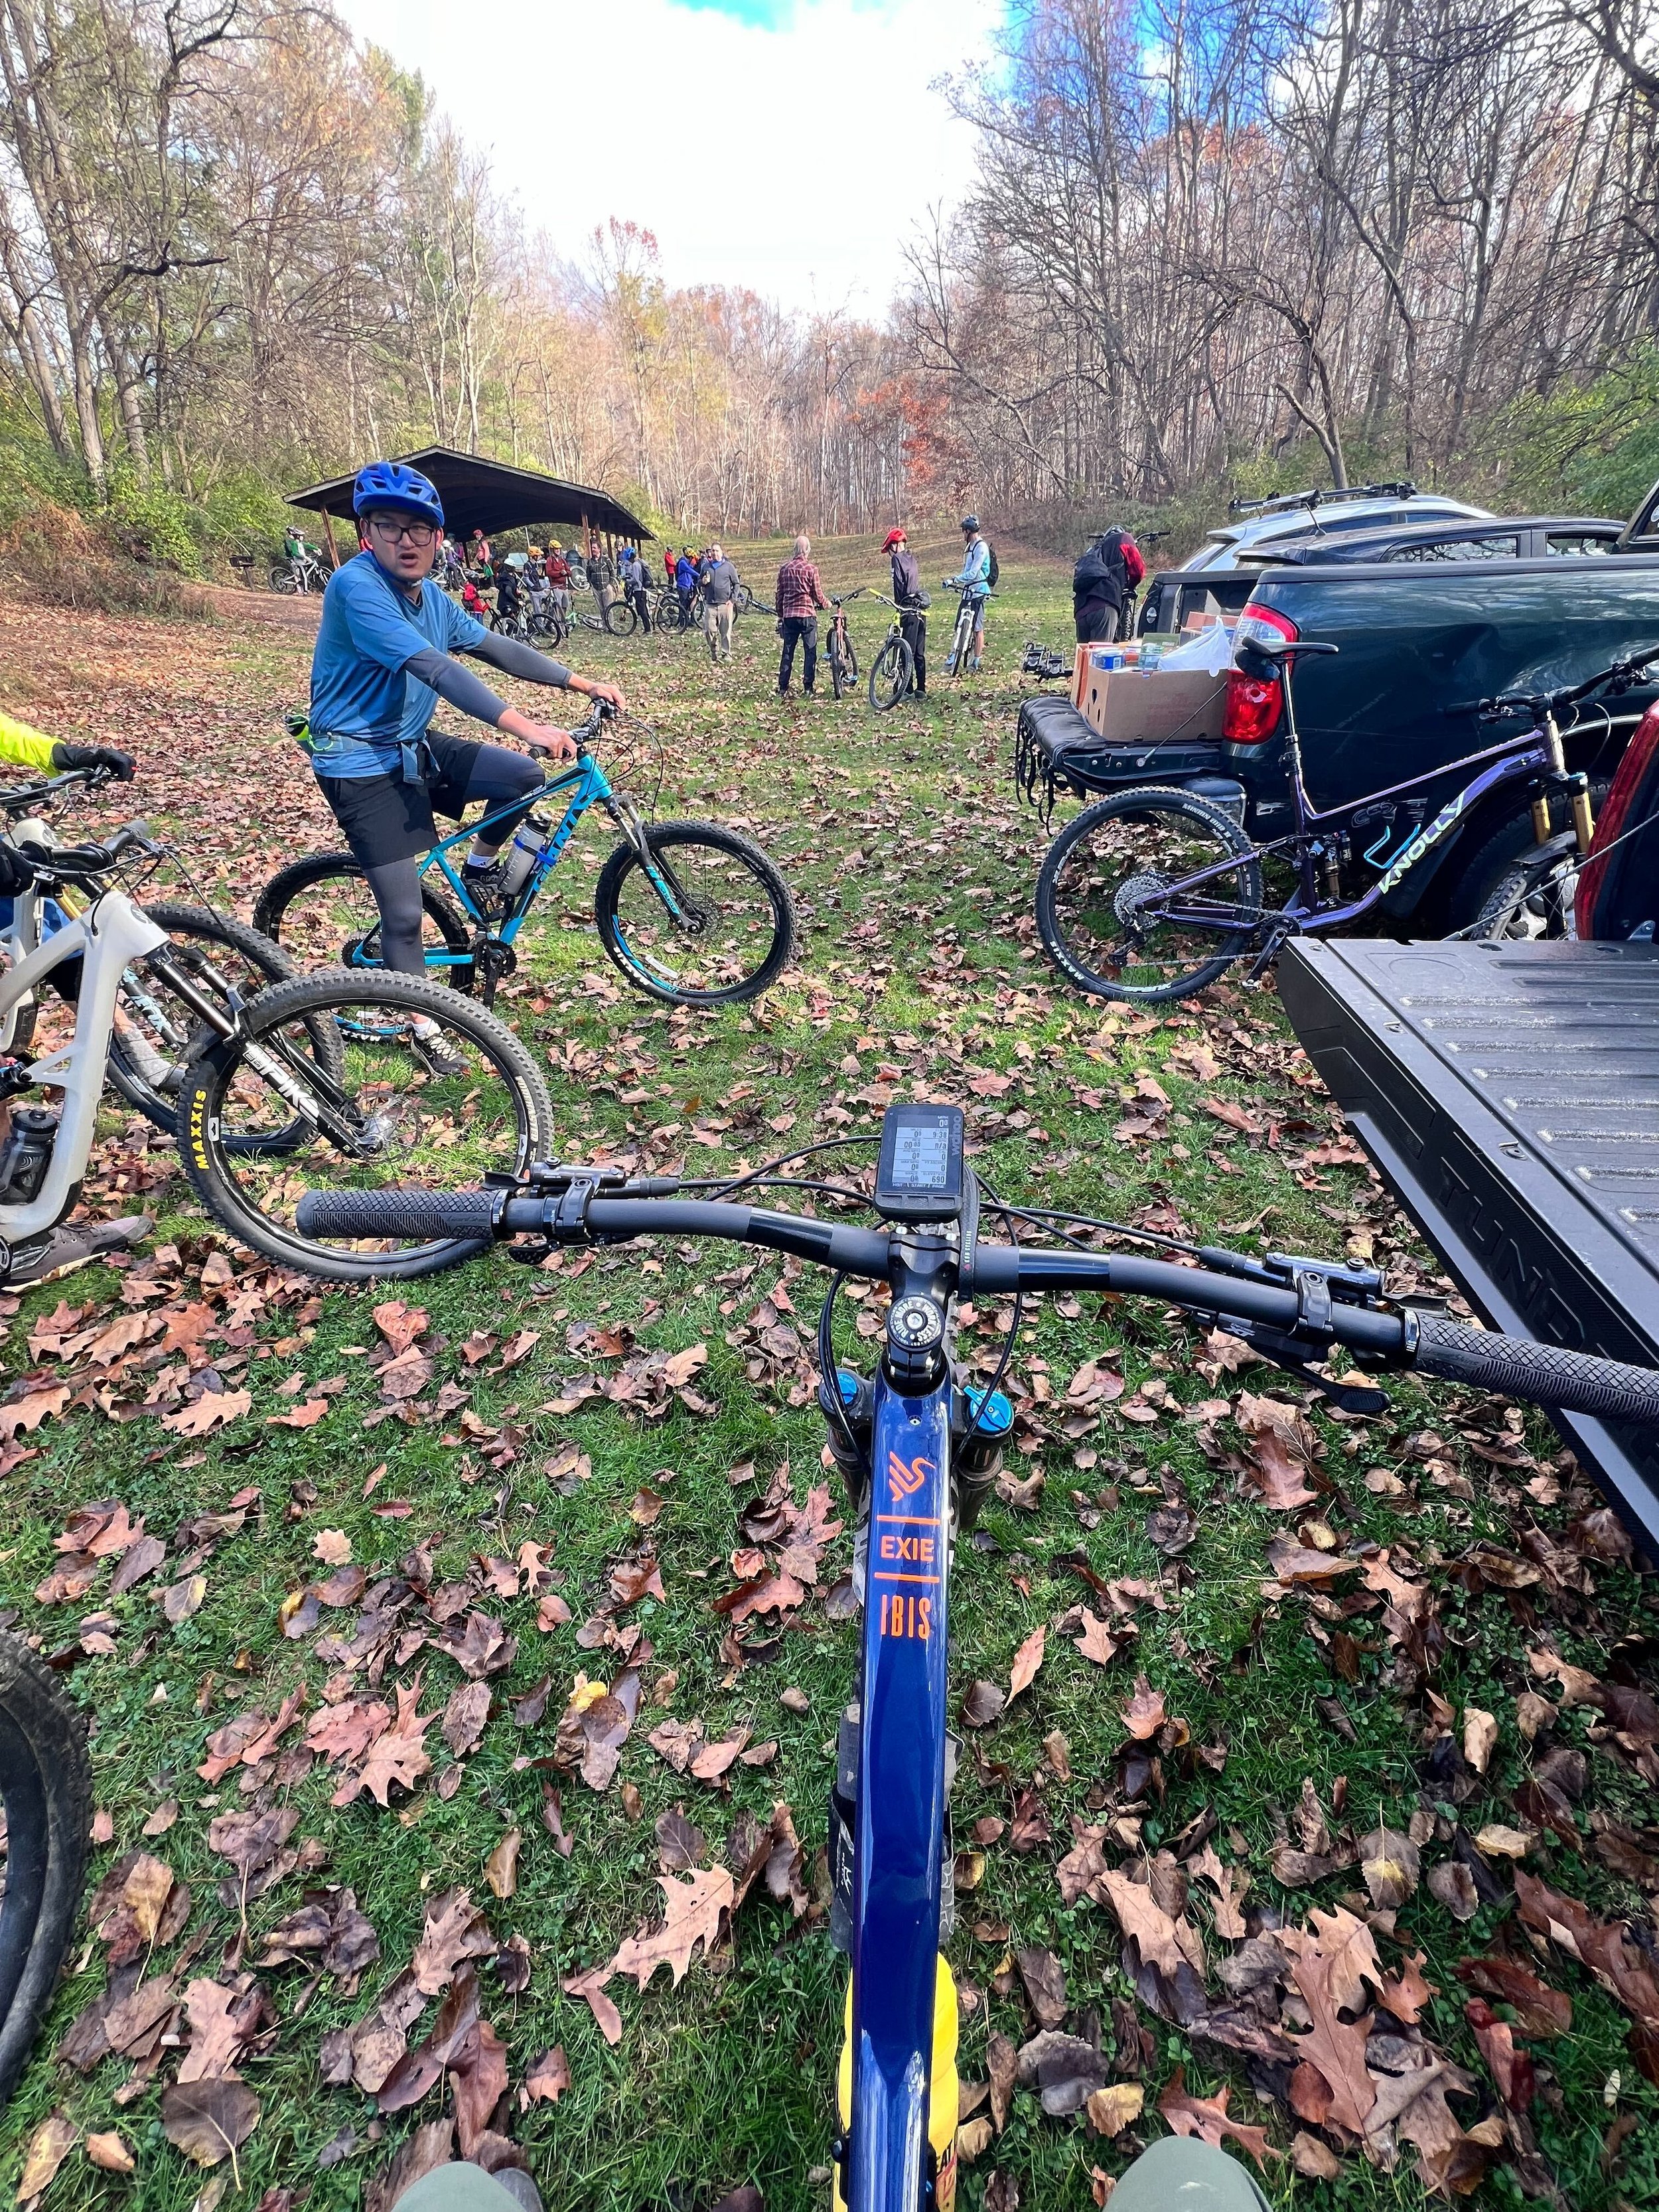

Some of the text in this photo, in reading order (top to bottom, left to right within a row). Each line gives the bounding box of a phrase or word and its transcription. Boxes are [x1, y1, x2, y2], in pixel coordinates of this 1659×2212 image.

[532, 809, 579, 892] GIANT
[1378, 791, 1465, 894] KNOLLY
[613, 946, 650, 986] MAXXIS
[1050, 940, 1085, 980] MAXXIS
[338, 1028, 382, 1041] MAXX
[259, 1061, 319, 1126] PIKE
[190, 1090, 210, 1169] MAXXIS
[949, 1115, 962, 1156] wahoo
[1437, 1156, 1594, 1351] TUND
[894, 1301, 914, 1339] RIDE MORE
[916, 1303, 936, 1341] WORK LESS
[880, 1535, 934, 1562] EXIE
[880, 1593, 932, 1640] IBIS
